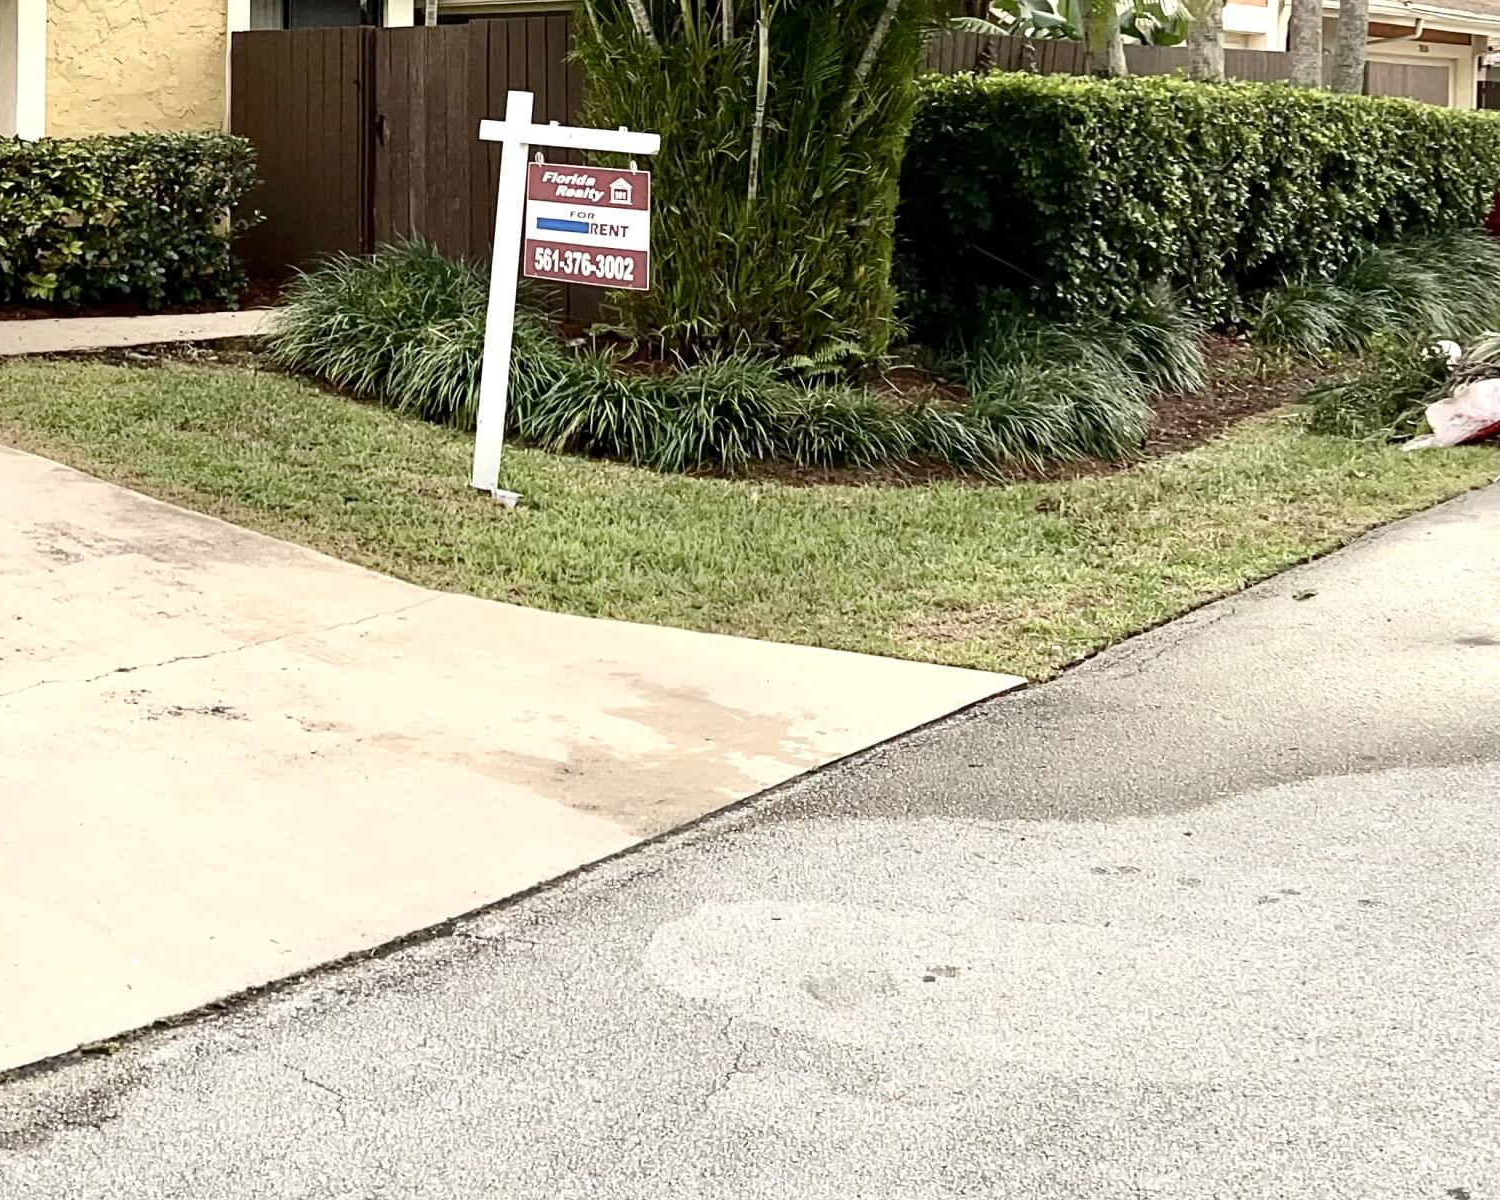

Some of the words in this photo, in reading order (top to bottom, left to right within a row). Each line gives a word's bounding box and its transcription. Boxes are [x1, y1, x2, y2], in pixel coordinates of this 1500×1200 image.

[542, 171, 596, 187] Florida
[555, 185, 605, 202] Realty
[570, 211, 595, 219] FOR
[590, 223, 629, 237] RENT
[534, 247, 634, 281] 561-376-3002
